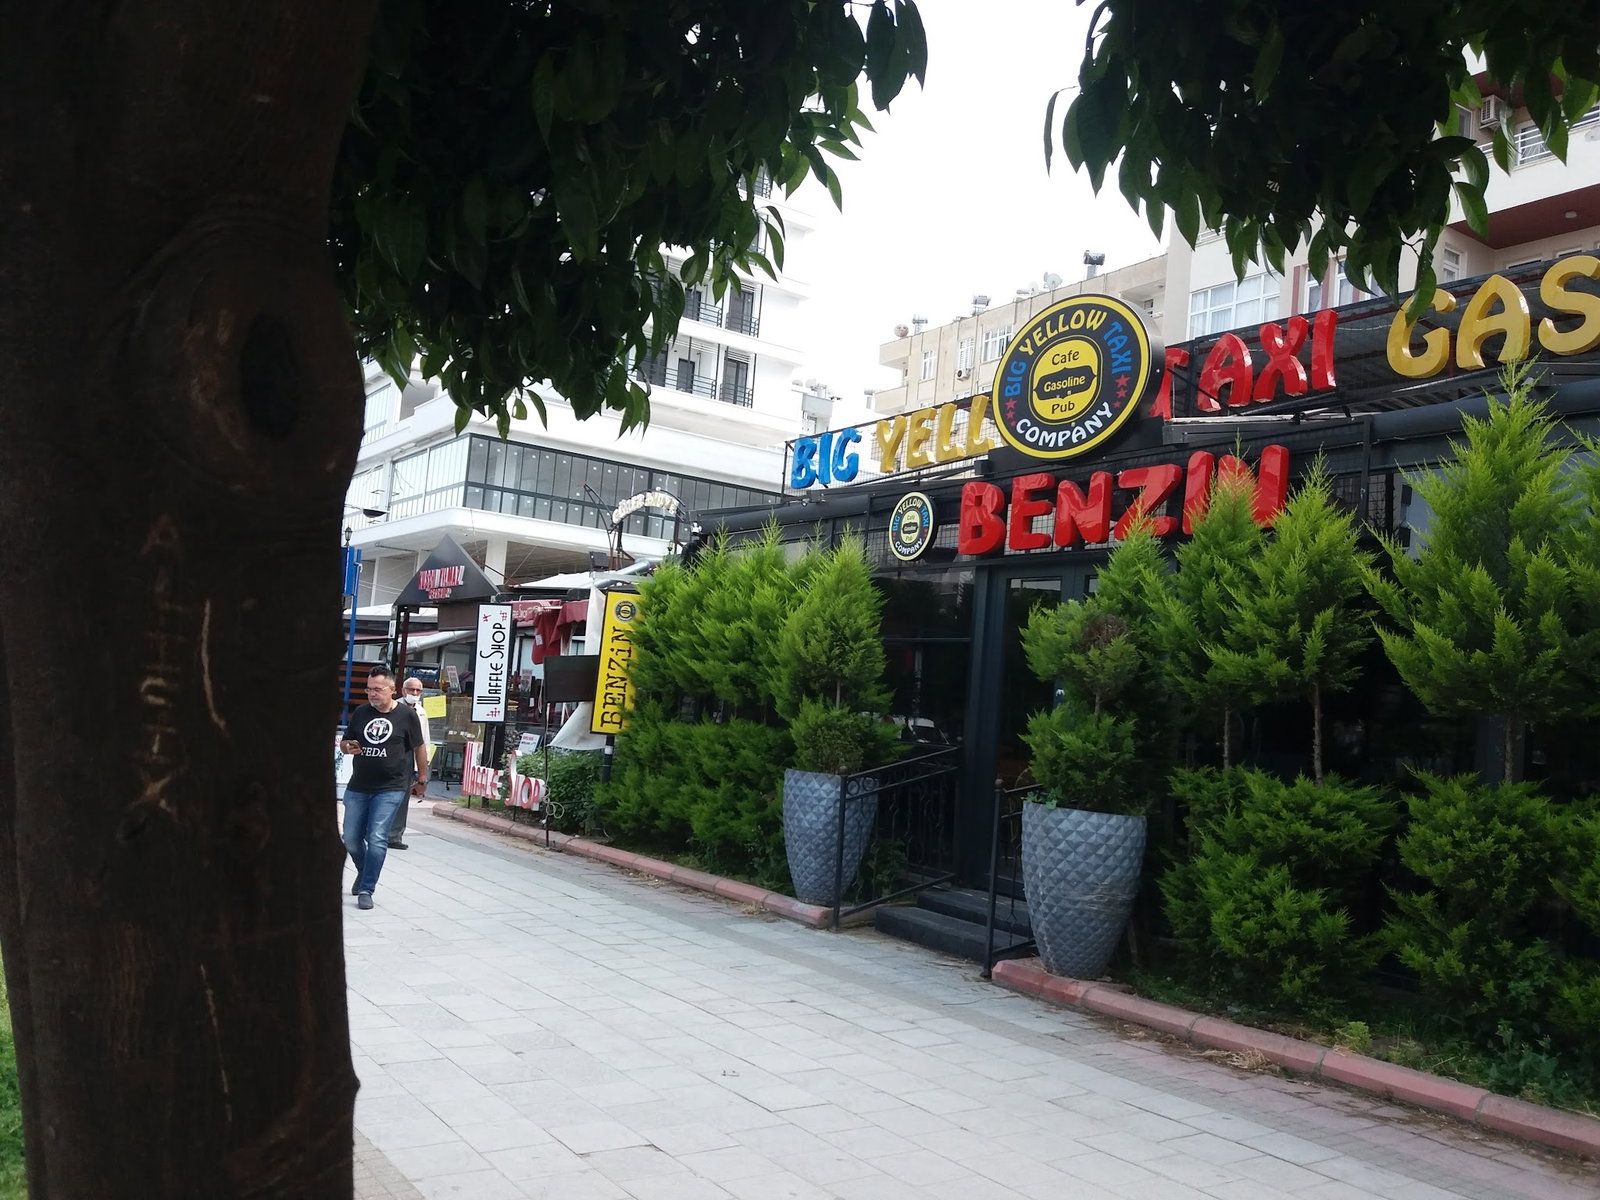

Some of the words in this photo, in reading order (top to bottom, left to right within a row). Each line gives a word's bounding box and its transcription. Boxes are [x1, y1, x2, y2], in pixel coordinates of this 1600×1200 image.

[1004, 360, 1027, 397] BIG
[1018, 309, 1108, 356] YELLOW
[1103, 321, 1132, 375] TAXI
[1051, 350, 1080, 366] Cafe
[791, 427, 862, 489] BIG
[876, 395, 996, 473] YELL
[1386, 255, 1600, 379] GAS
[1043, 375, 1086, 393] Gasoline
[1016, 401, 1113, 448] COMPANY
[1051, 400, 1075, 415] Pub
[898, 498, 923, 514] YELLOW
[921, 505, 929, 527] TAXI
[895, 538, 923, 555] COMPANY
[480, 622, 506, 659] SHOP
[476, 663, 504, 705] WAFFLE
[504, 749, 546, 811] SHOP
